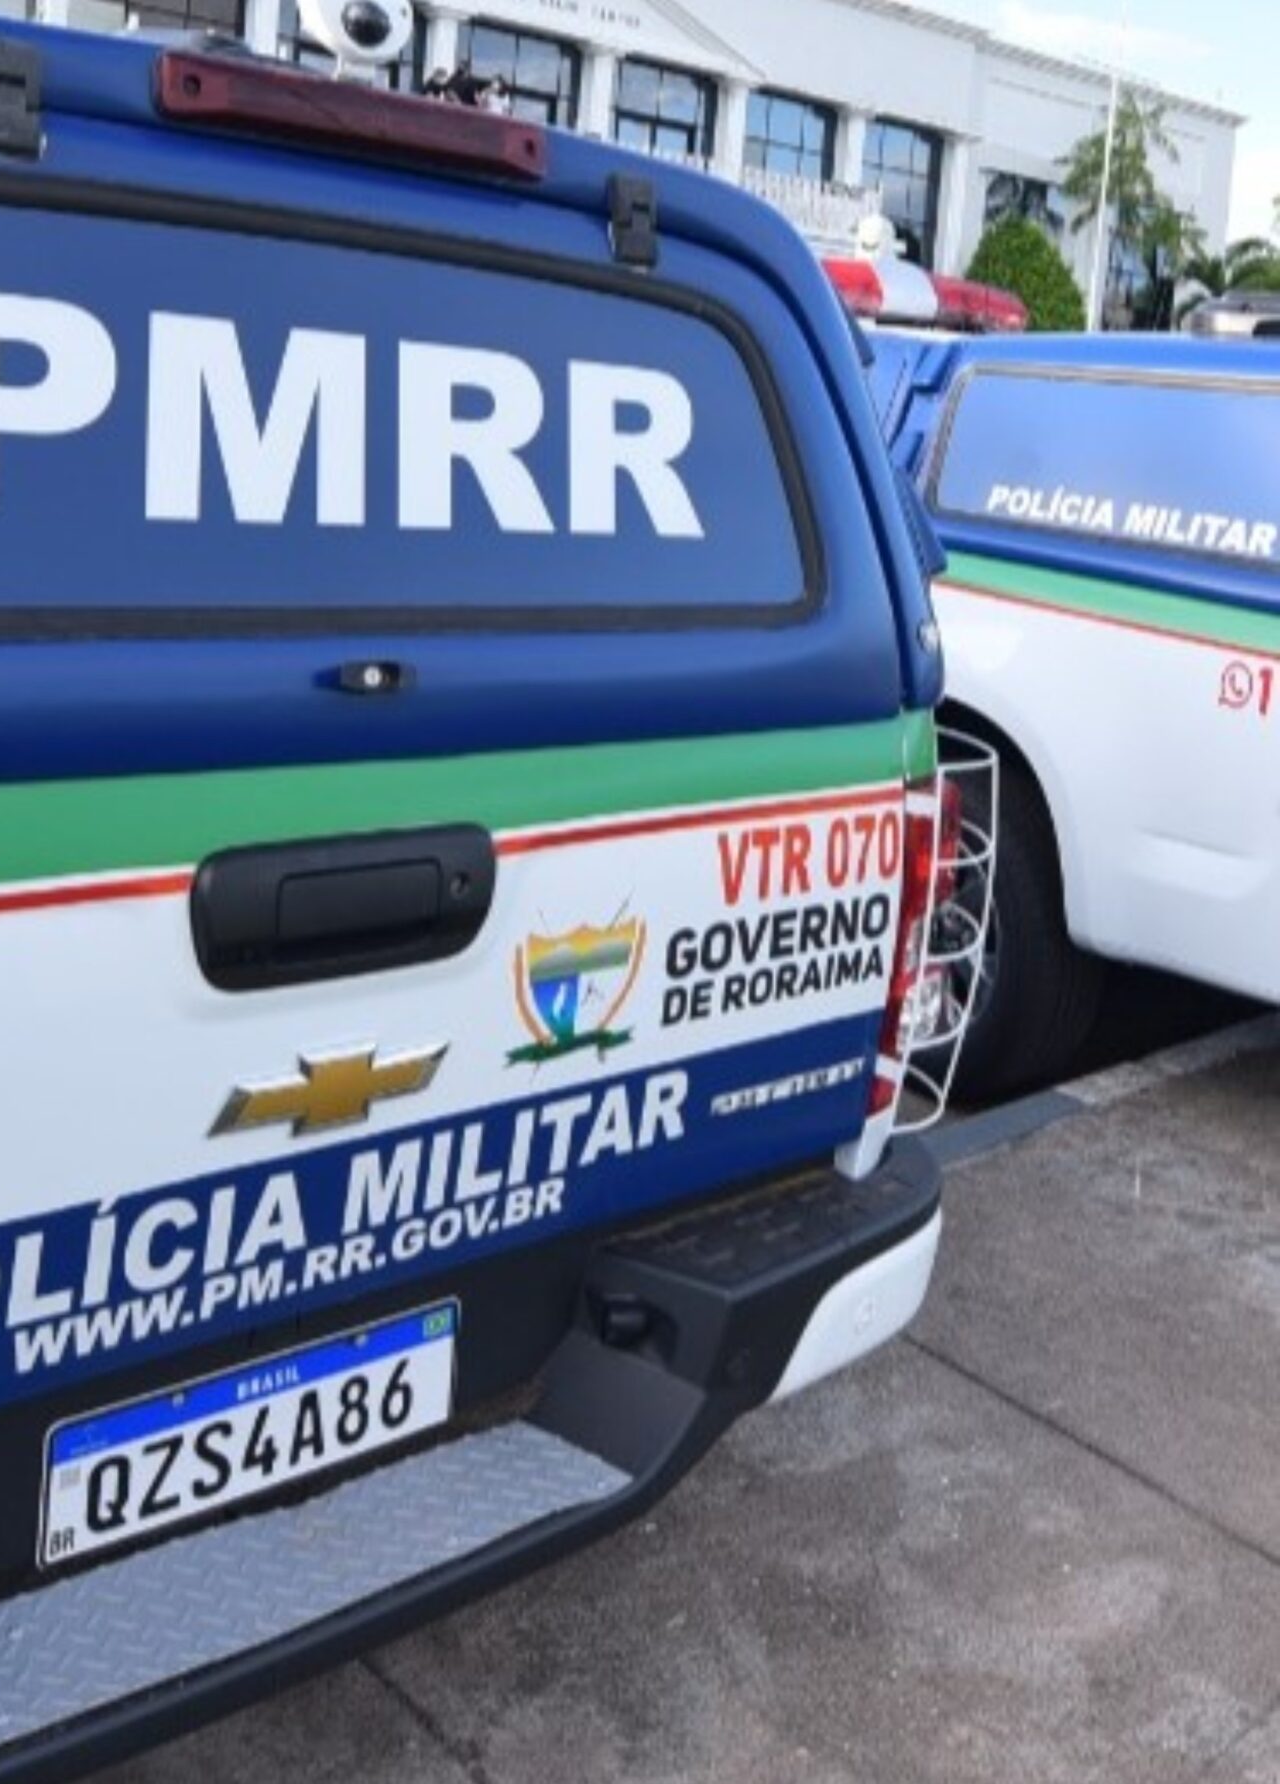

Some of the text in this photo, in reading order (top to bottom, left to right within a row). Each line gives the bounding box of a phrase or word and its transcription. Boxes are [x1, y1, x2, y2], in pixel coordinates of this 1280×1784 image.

[986, 483, 1277, 557] POLÍCIA MILITAR
[718, 811, 901, 906] VTR 070
[666, 892, 891, 979] GOVERNO
[661, 945, 884, 1026] DE RORAIMA
[341, 1069, 688, 1237] MILITAR
[14, 1178, 566, 1374] WWW.PM.RR.GOV.BR
[236, 1365, 301, 1402] BRASIL
[85, 1358, 413, 1533] QZS4A86
[48, 1526, 75, 1557] BR
